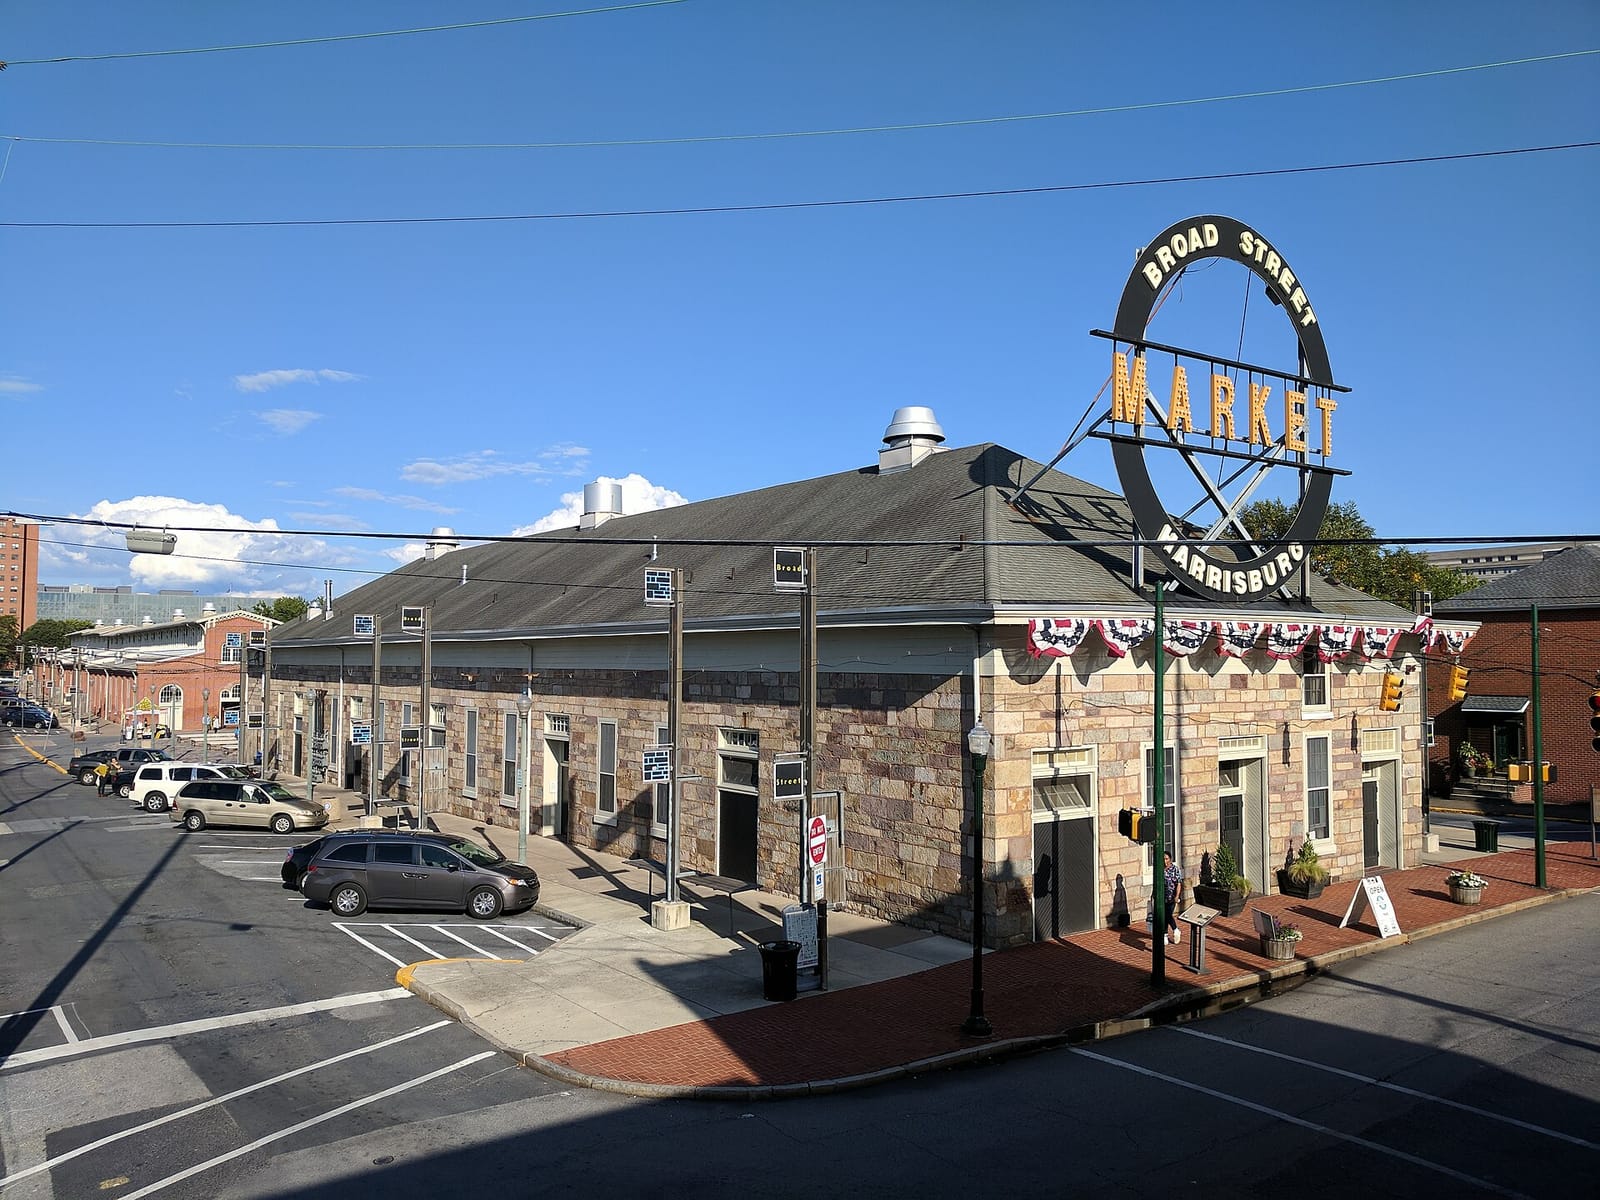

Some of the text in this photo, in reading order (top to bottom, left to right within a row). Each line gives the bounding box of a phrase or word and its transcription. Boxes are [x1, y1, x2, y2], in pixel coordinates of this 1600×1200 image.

[1142, 223, 1317, 326] BROAD STREET
[1111, 352, 1338, 457] MARKET
[776, 563, 802, 572] Broad
[1157, 523, 1304, 595] HARRISBURG
[776, 777, 801, 786] Street
